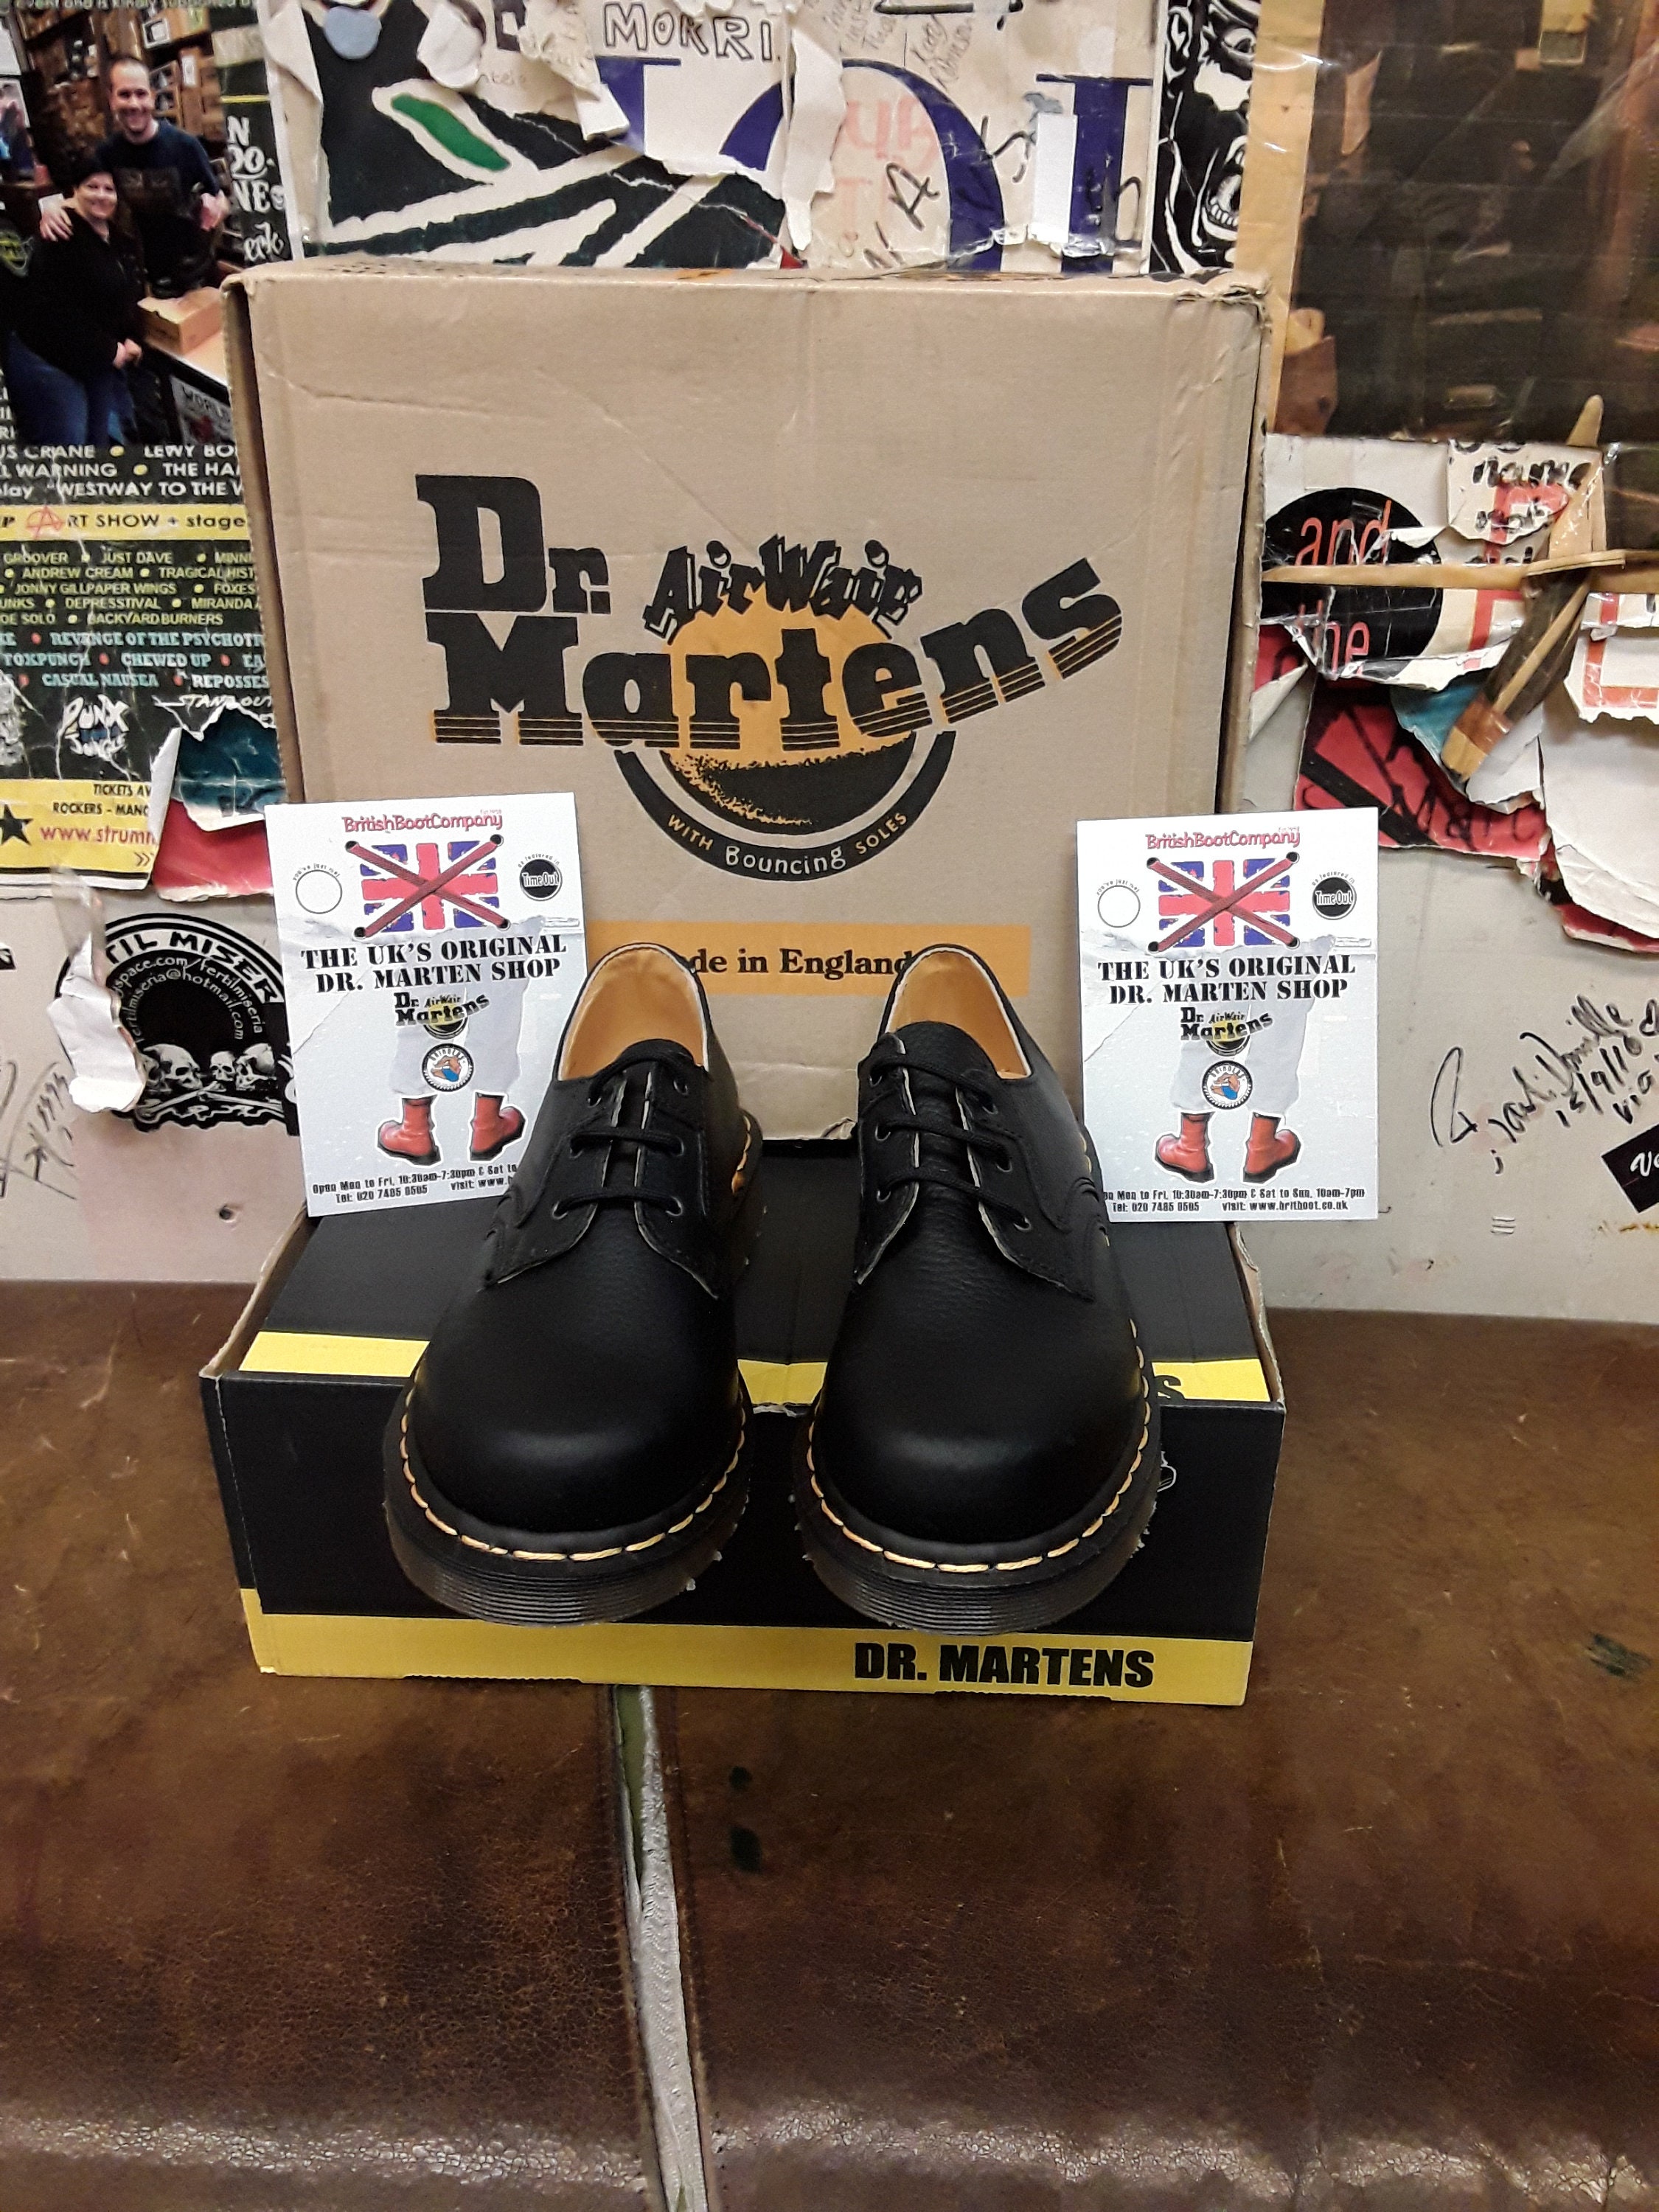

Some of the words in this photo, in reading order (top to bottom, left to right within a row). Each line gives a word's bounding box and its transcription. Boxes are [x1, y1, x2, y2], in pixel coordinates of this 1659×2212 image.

[24, 444, 96, 459] CRANE
[15, 463, 118, 478] WARNING
[162, 463, 198, 477] THE
[158, 481, 187, 496] TO
[190, 481, 227, 496] THE
[96, 515, 159, 527] SHOW
[135, 552, 173, 565] DAVE
[22, 567, 80, 579] ANDREW
[85, 567, 134, 579] CREAM
[191, 598, 253, 609] MIRANDA
[161, 613, 223, 625] BURNERS
[49, 631, 125, 646] REVENGE
[125, 632, 147, 646] OF
[147, 632, 180, 647] THE
[121, 653, 188, 667] CHEWED
[189, 653, 212, 667] UP
[424, 557, 1124, 750] Martens
[94, 783, 133, 796] TICKETS
[52, 801, 102, 815] ROCKERS
[341, 812, 503, 832] BritishBootCompany
[667, 813, 714, 853] WITH
[724, 844, 846, 876] Bouncing
[855, 811, 908, 856] SOLES
[1145, 830, 1301, 850] BritishBootCompany
[300, 947, 358, 970] THE
[366, 942, 432, 965] UK'S
[441, 933, 568, 960] ORIGINAL
[737, 947, 770, 975] in
[1097, 960, 1149, 982] THE
[1159, 957, 1220, 980] UK'S
[1228, 954, 1357, 978] ORIGINAL
[315, 971, 364, 994] DR.
[375, 962, 481, 990] MARTEN
[490, 958, 561, 982] SHOP
[1108, 984, 1153, 1005] DR.
[1163, 980, 1267, 1003] MARTEN
[1276, 978, 1349, 1001] SHOP
[394, 994, 490, 1026] Martens
[1180, 1012, 1274, 1041] Martens
[313, 1183, 337, 1194] Open
[339, 1181, 361, 1192] Mon
[364, 1178, 375, 1189] to
[487, 1164, 504, 1175] Sat
[335, 1192, 353, 1203] Tel:
[451, 1180, 476, 1192] visit:
[1117, 1190, 1136, 1201] Mon
[1140, 1190, 1150, 1200] to
[1259, 1189, 1276, 1199] Sat
[1280, 1189, 1290, 1198] to
[1316, 1187, 1366, 1200] 10am-7pm
[1113, 1202, 1129, 1212] Tel:
[1132, 1202, 1149, 1212] 020
[1222, 1201, 1247, 1211] visit:
[855, 1641, 928, 1681] DR.
[939, 1644, 1155, 1688] MARTENS
